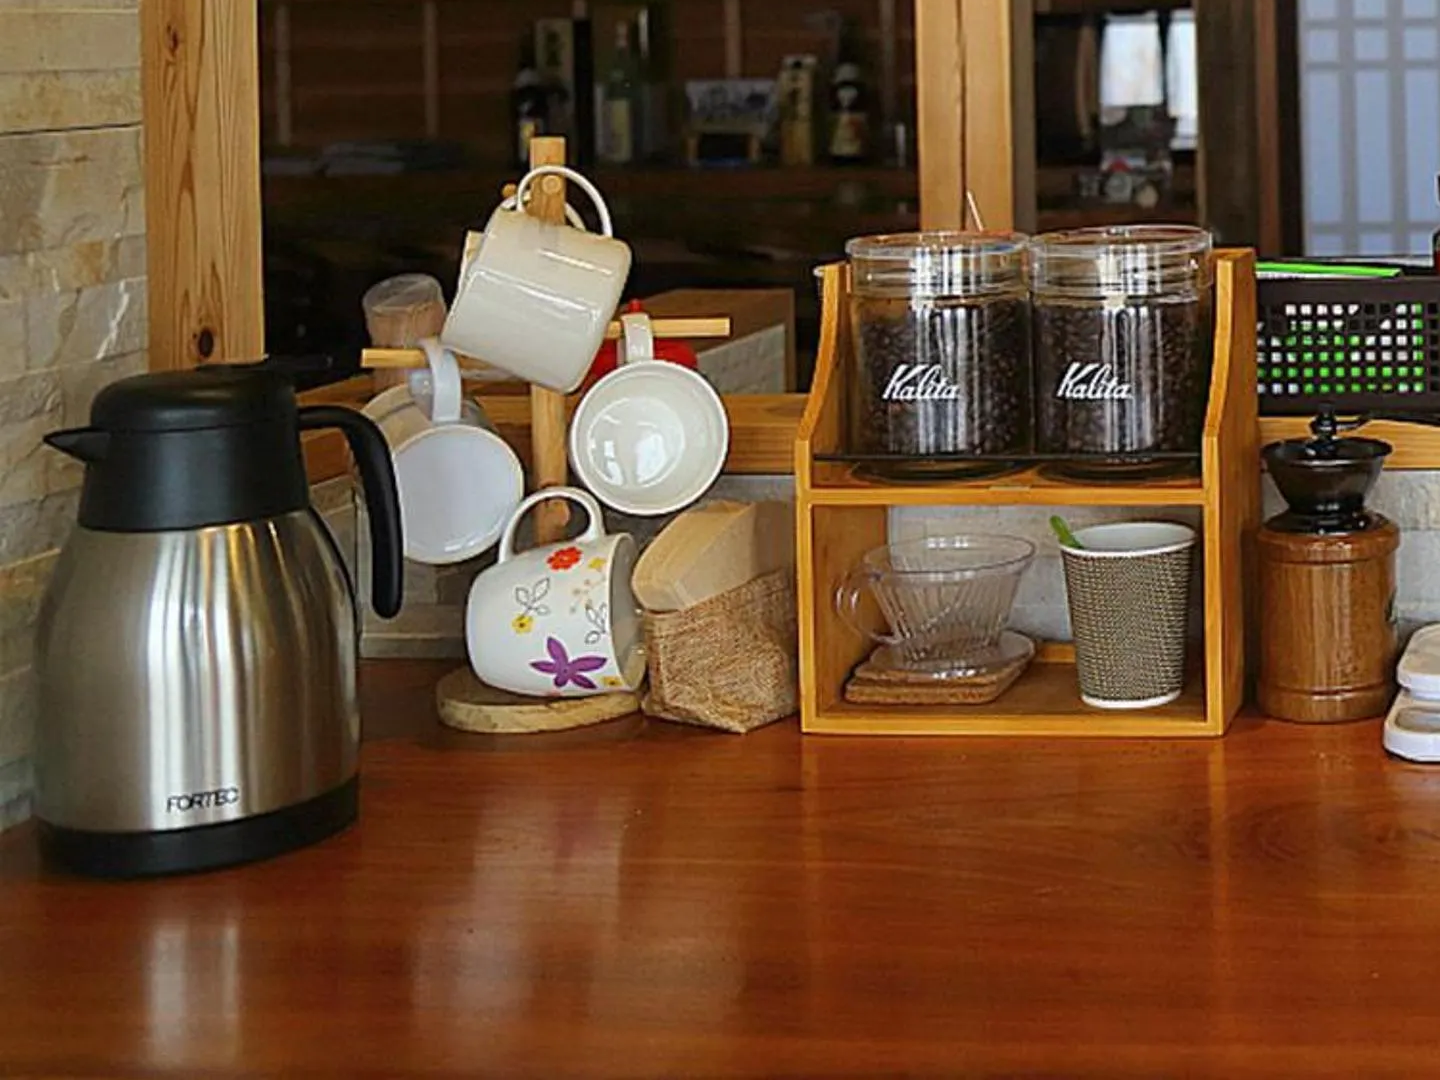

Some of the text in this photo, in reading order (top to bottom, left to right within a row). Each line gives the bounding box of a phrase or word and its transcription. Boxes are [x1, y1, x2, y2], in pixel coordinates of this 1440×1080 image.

[882, 363, 960, 400] Kalita
[1056, 362, 1132, 400] Kalita
[166, 786, 239, 813] FORTEC
